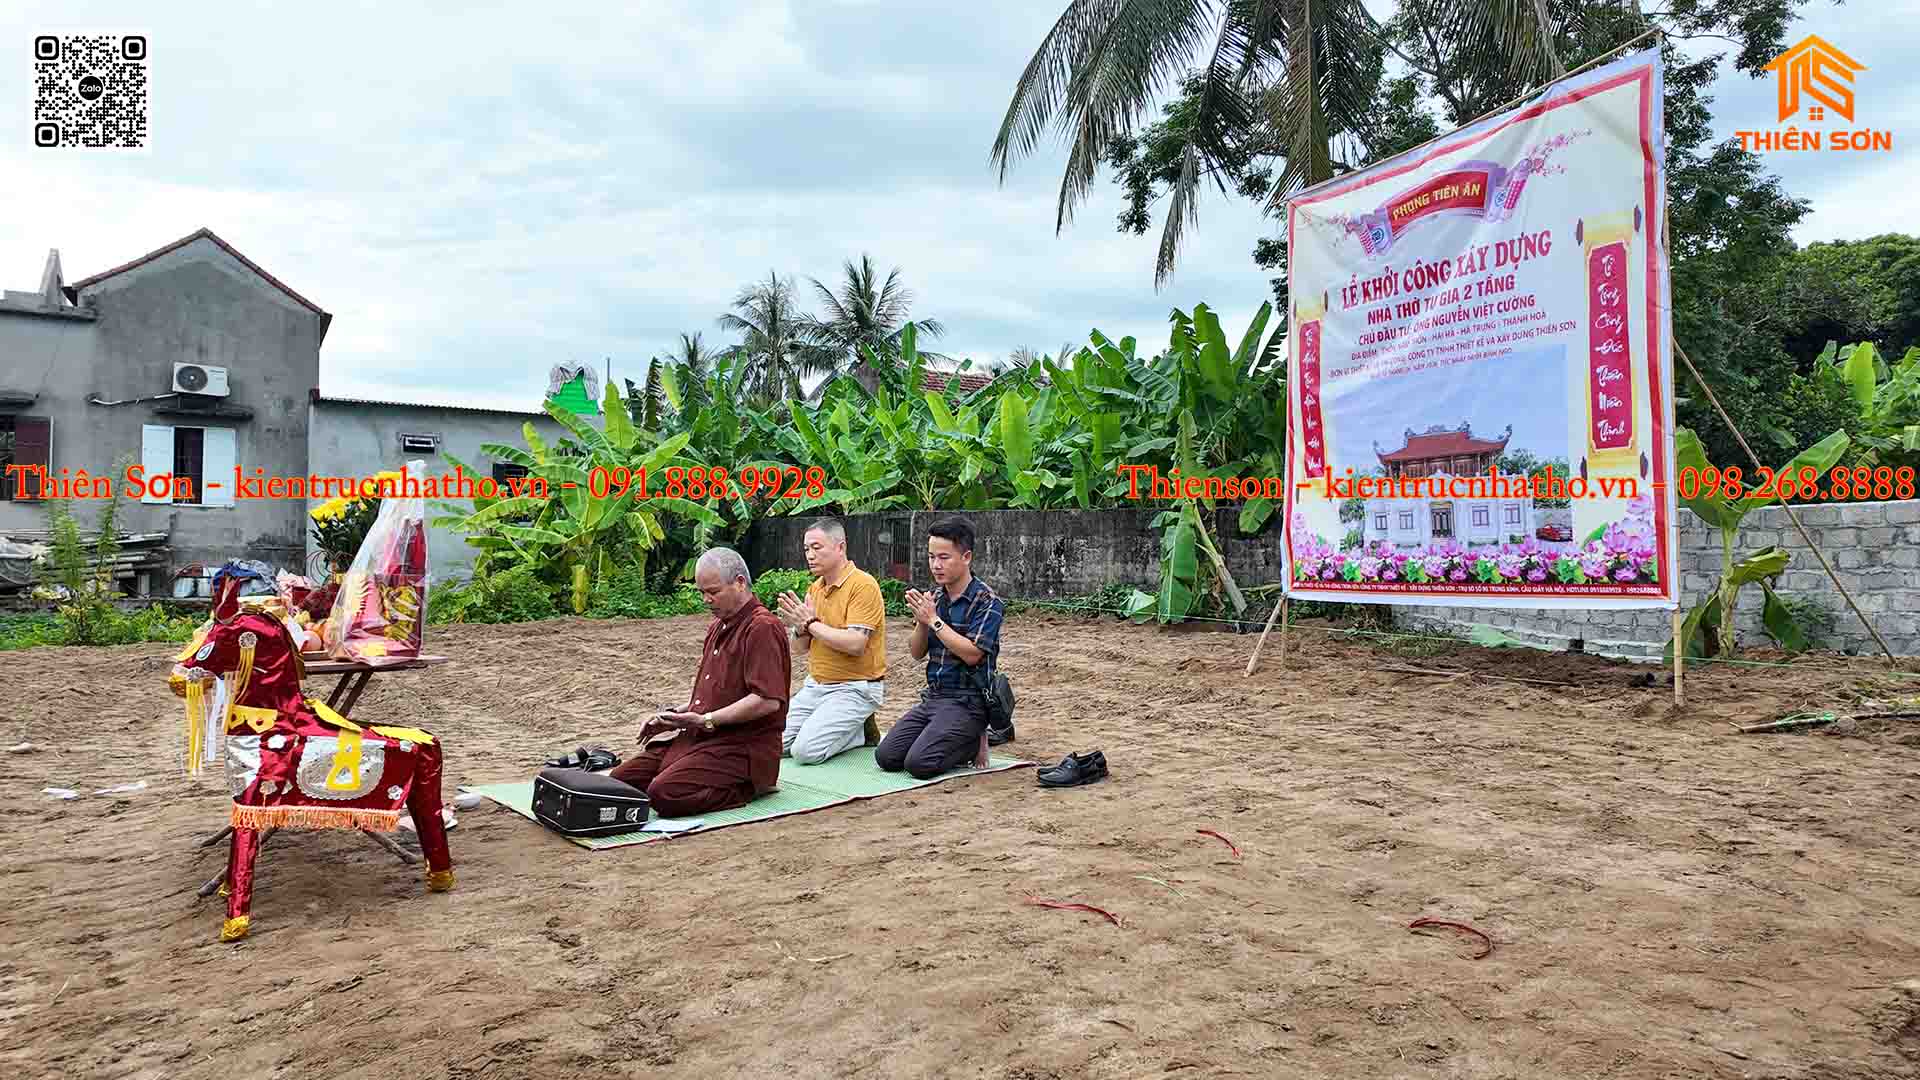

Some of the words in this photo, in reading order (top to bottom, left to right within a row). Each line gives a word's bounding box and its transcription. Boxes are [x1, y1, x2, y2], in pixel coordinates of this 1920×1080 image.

[1361, 264, 1399, 305] KHỞI
[1403, 256, 1451, 294] CÔNG
[1494, 230, 1553, 270] DỰNG
[1367, 303, 1393, 325] NHÀ
[1395, 296, 1421, 320] THỜ
[1439, 287, 1460, 307] GIA
[1464, 284, 1473, 300] 2
[1476, 273, 1515, 297] TẦNG
[1377, 325, 1397, 342] ĐẦU
[1431, 304, 1470, 328] NGUYỄN
[1472, 301, 1494, 319] VIỆT
[1497, 294, 1535, 314] CƯỜNG
